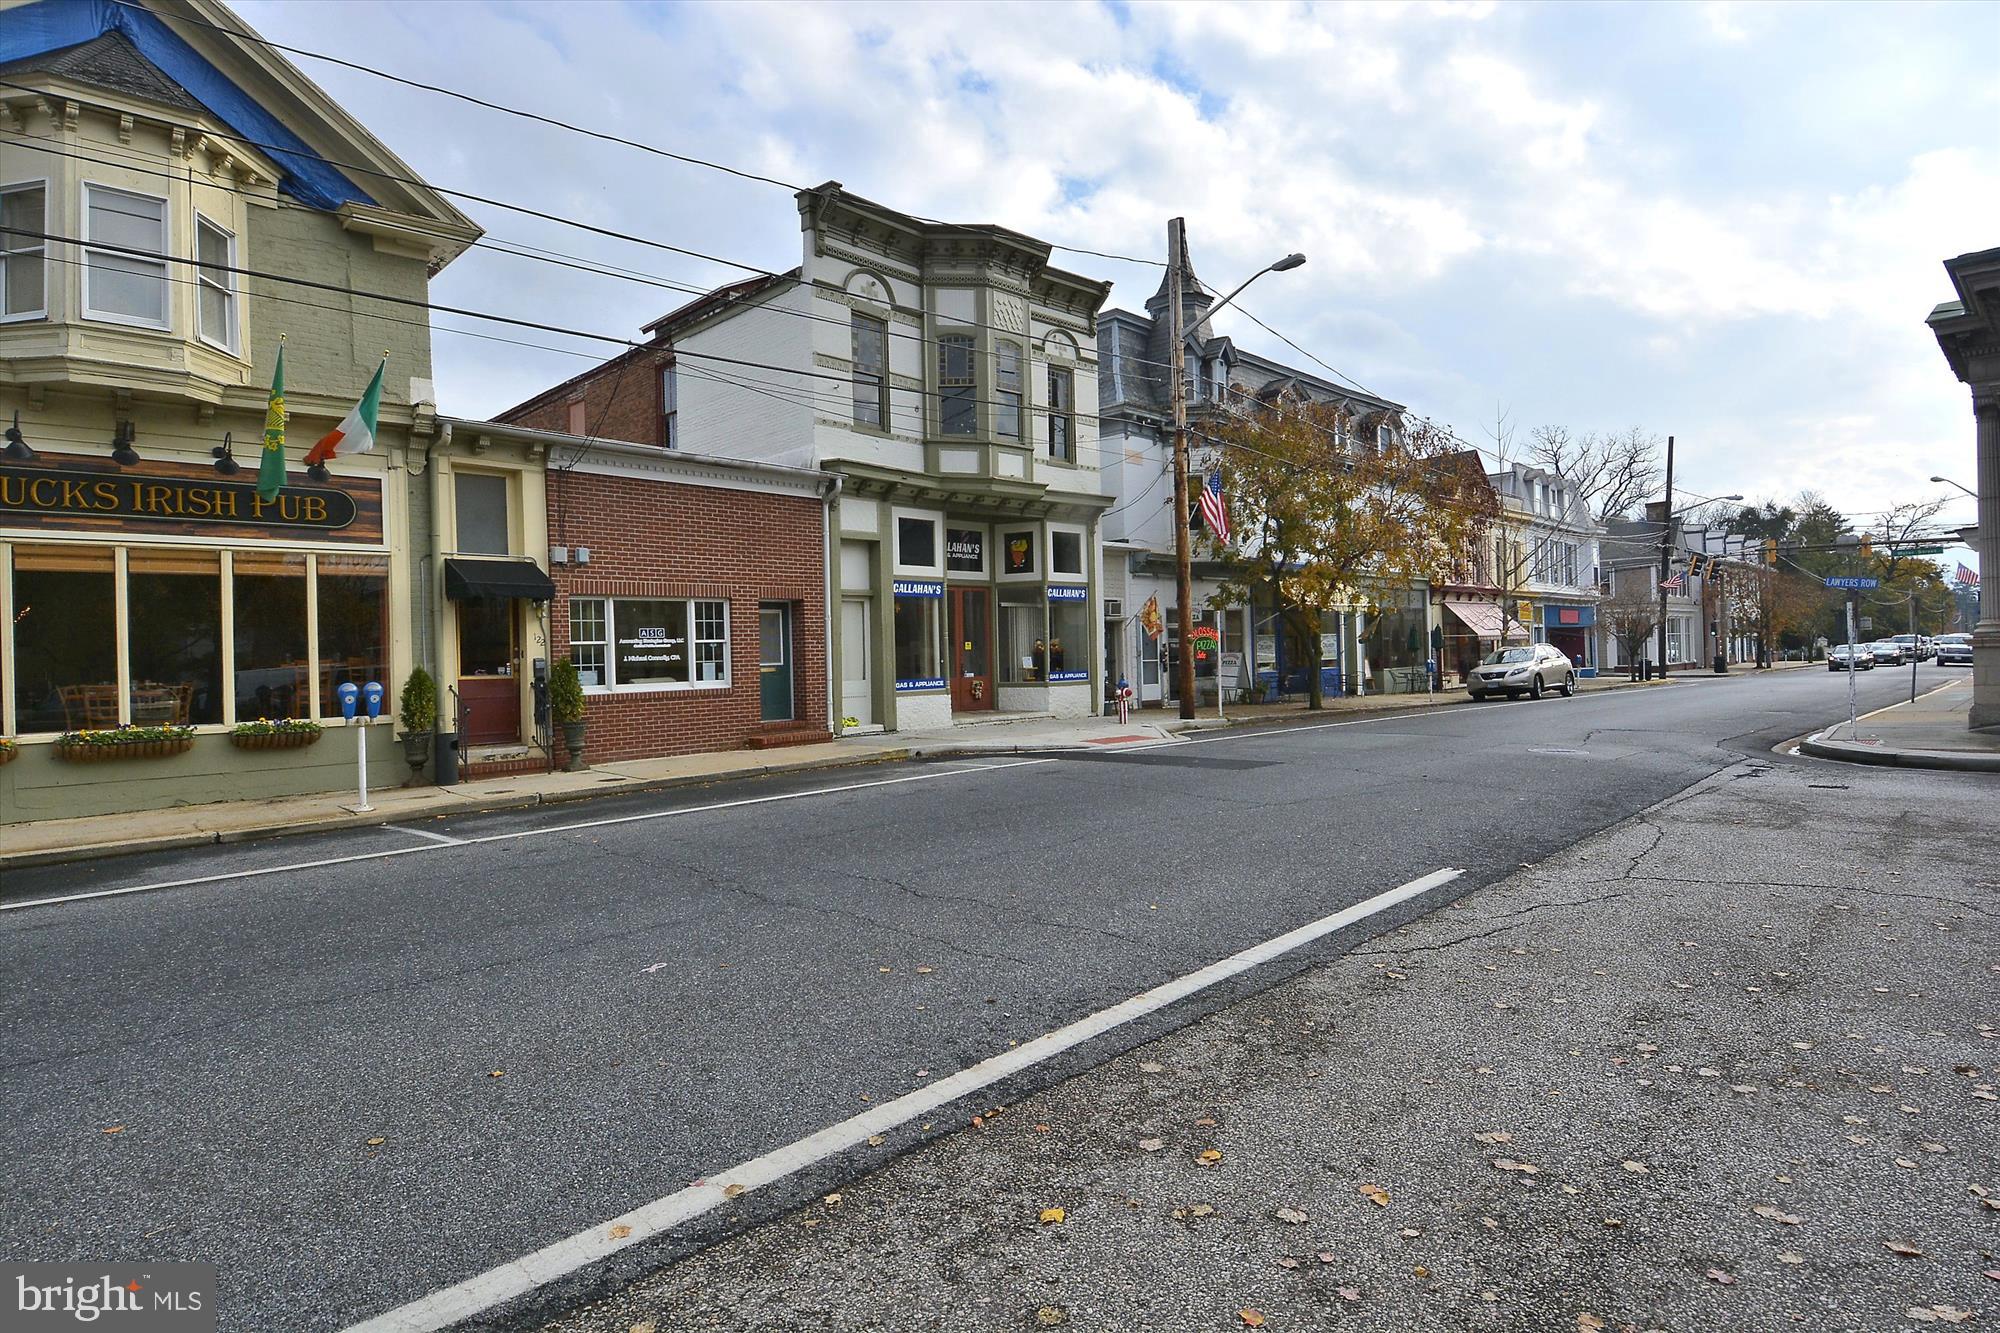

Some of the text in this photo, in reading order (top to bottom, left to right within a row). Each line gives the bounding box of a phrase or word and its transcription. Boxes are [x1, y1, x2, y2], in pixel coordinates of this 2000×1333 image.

[0, 476, 328, 521] UCKS IRISH PUB
[1825, 578, 1877, 588] LAWYERS ROW
[893, 583, 942, 595] CALLAHAN'S
[1047, 588, 1086, 598] CALLAHAN'S
[640, 629, 664, 638] ASG
[534, 632, 546, 646] 122
[1196, 640, 1216, 651] PIZZA
[914, 680, 944, 688] APPLIANCE
